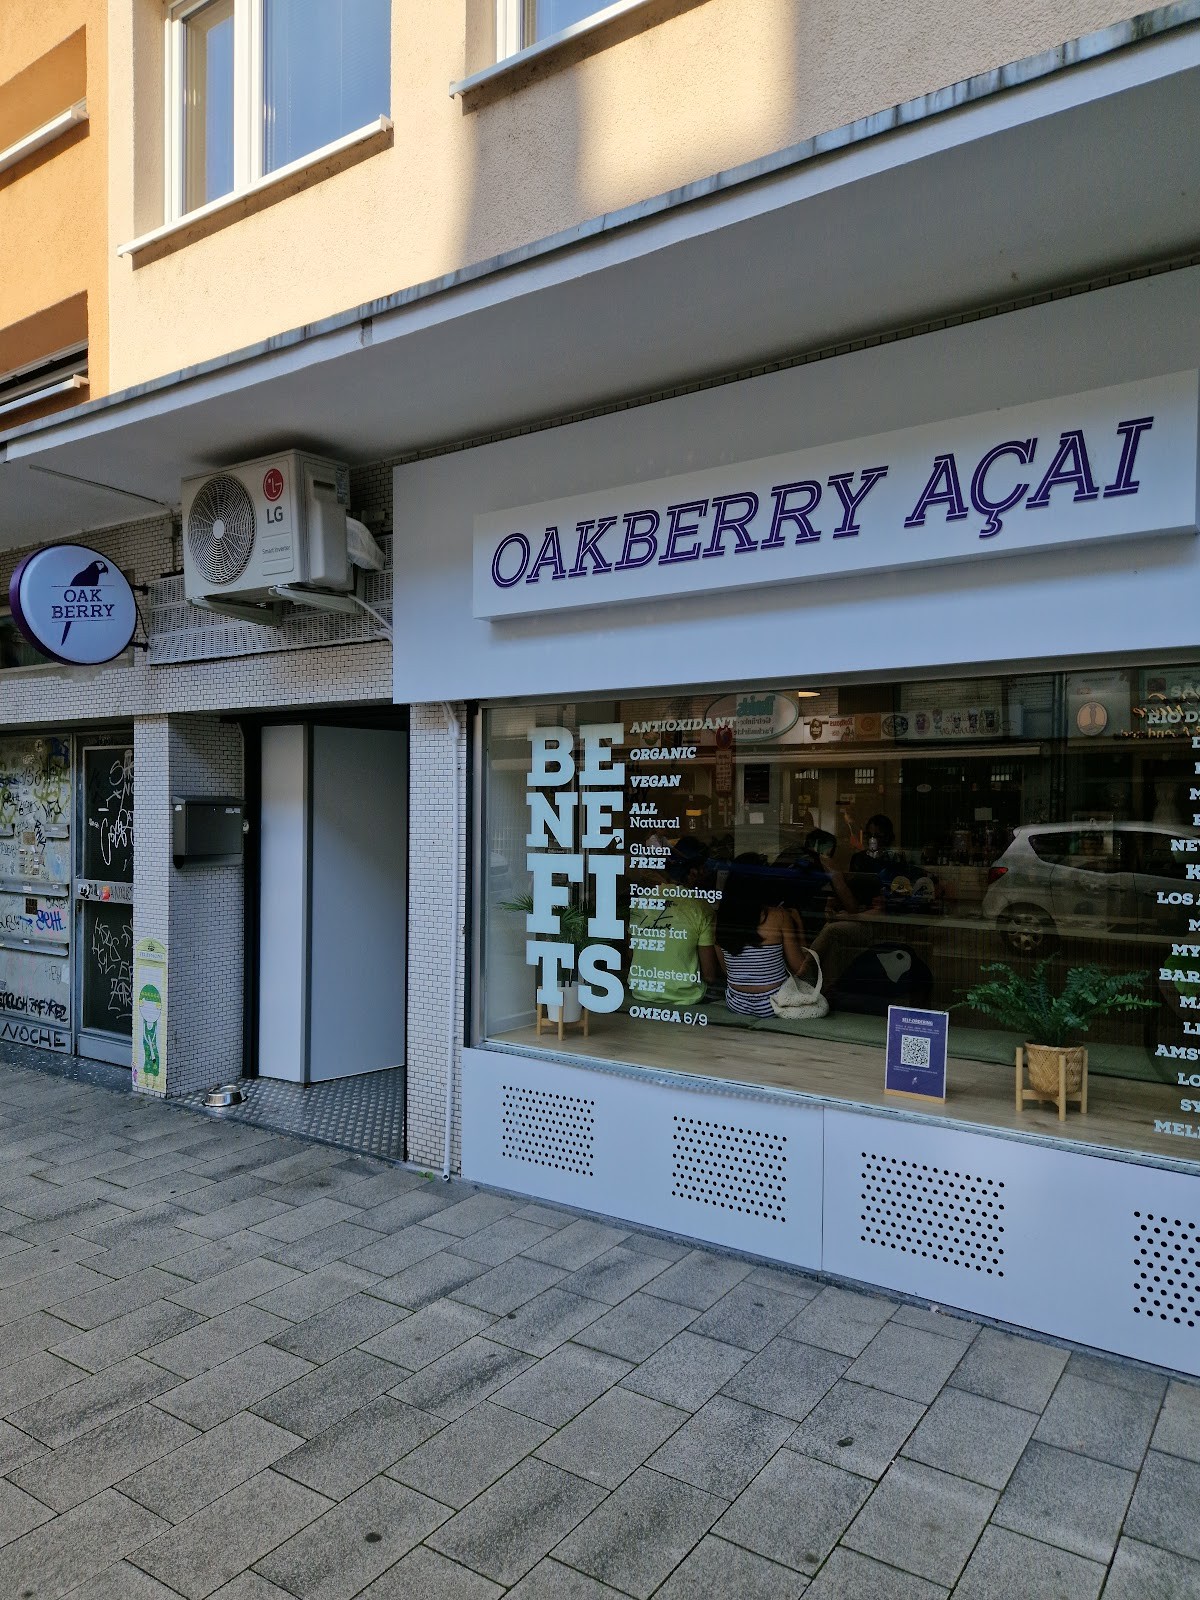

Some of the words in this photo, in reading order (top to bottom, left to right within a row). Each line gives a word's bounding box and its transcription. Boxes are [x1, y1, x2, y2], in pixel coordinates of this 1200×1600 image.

[491, 465, 889, 588] OAKBERRY
[904, 416, 1155, 540] AÇAI
[266, 505, 284, 524] LG
[63, 588, 103, 603] OAK
[51, 603, 115, 619] BERRY
[1170, 681, 1200, 699] SÃ
[630, 717, 737, 734] ANTIOXIDANT
[1147, 711, 1182, 724] RIO
[1184, 711, 1200, 723] D
[526, 723, 625, 787] BE
[630, 746, 697, 761] ORGANIC
[630, 774, 682, 788] VEGAN
[629, 803, 658, 815] ALL
[630, 817, 680, 829] Natural
[630, 843, 671, 856] Gluten
[1171, 839, 1200, 852] NE
[629, 857, 666, 870] FREE
[526, 853, 625, 940] FI
[630, 884, 660, 897] Food
[662, 887, 723, 904] colorings
[1157, 891, 1193, 906] LOS
[629, 898, 666, 911] FREE
[630, 924, 666, 939] Trans
[668, 927, 688, 940] fat
[629, 938, 666, 952] FREE
[526, 940, 625, 1014] TS
[630, 965, 702, 984] Cholesterol
[629, 979, 666, 993] FREE
[629, 1005, 682, 1024] OMEGA
[683, 1012, 708, 1027] 6/9
[1155, 1044, 1200, 1061] AMS
[1154, 1119, 1200, 1139] MEL
